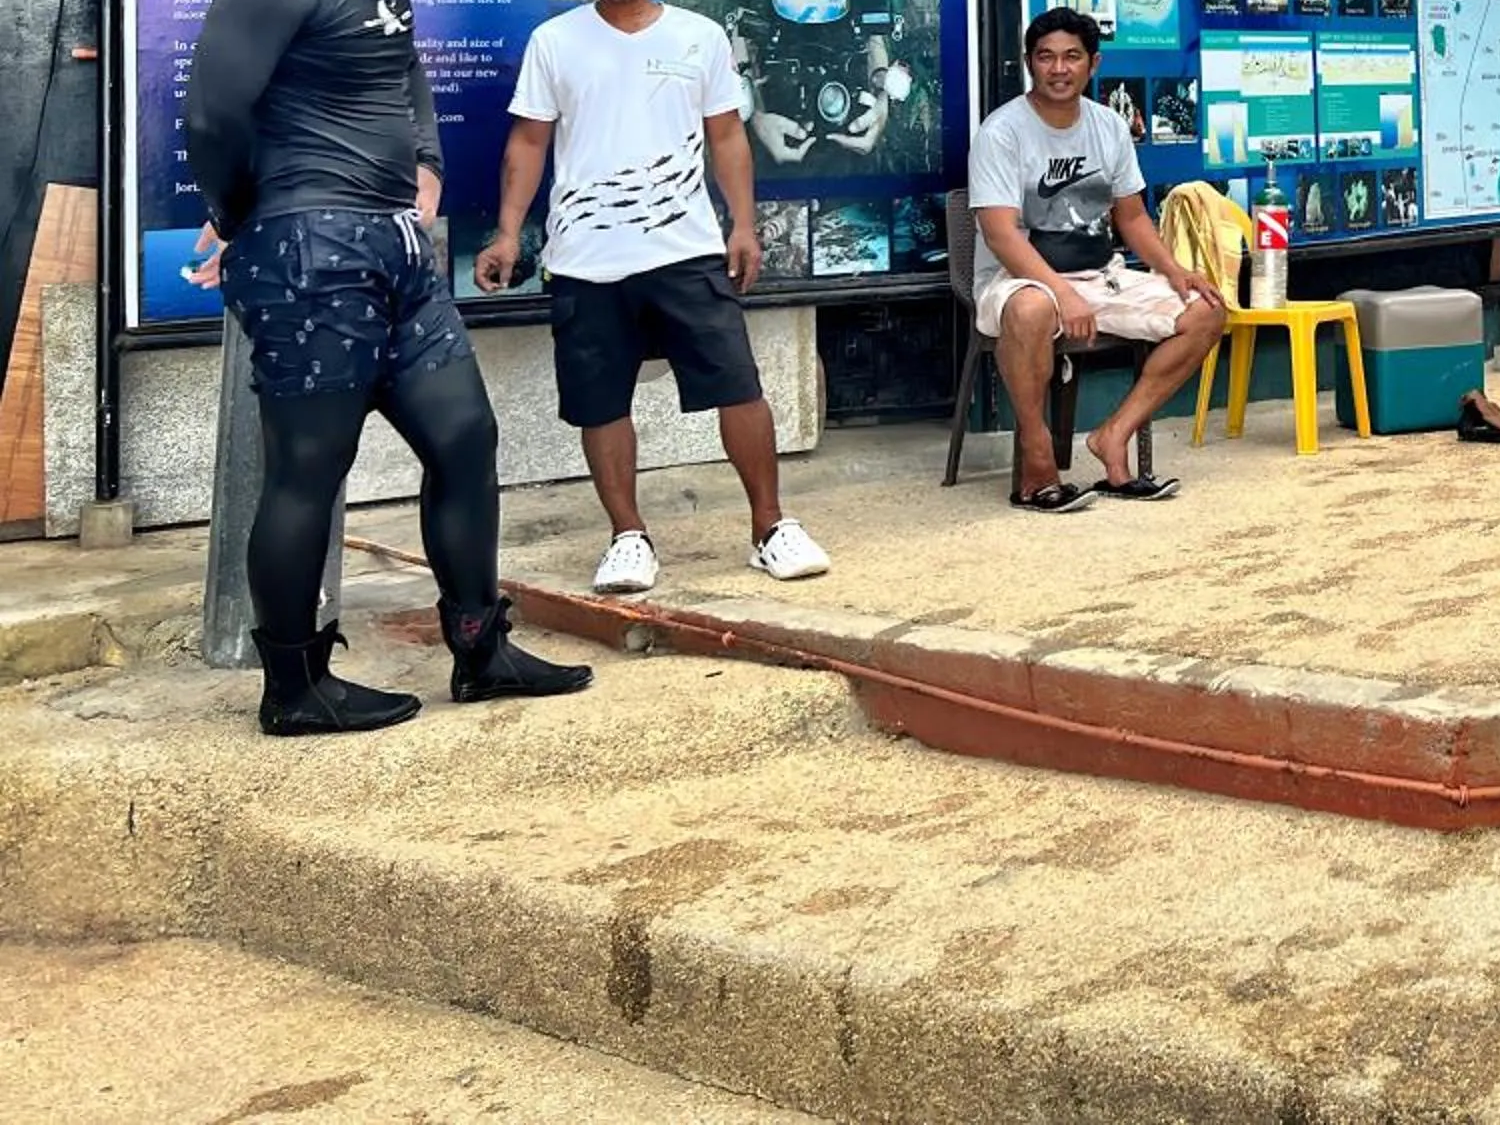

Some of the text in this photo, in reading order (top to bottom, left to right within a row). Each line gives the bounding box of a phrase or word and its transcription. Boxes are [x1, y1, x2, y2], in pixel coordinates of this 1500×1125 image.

[175, 40, 187, 51] In
[413, 37, 443, 50] uality
[447, 37, 467, 48] and
[470, 38, 490, 48] size
[492, 37, 504, 48] of
[435, 52, 456, 64] and
[459, 51, 478, 63] like
[481, 52, 493, 62] to
[440, 69, 451, 78] in
[453, 70, 473, 78] our
[475, 70, 498, 78] new
[1048, 155, 1087, 181] NIKE
[175, 182, 201, 195] Jori
